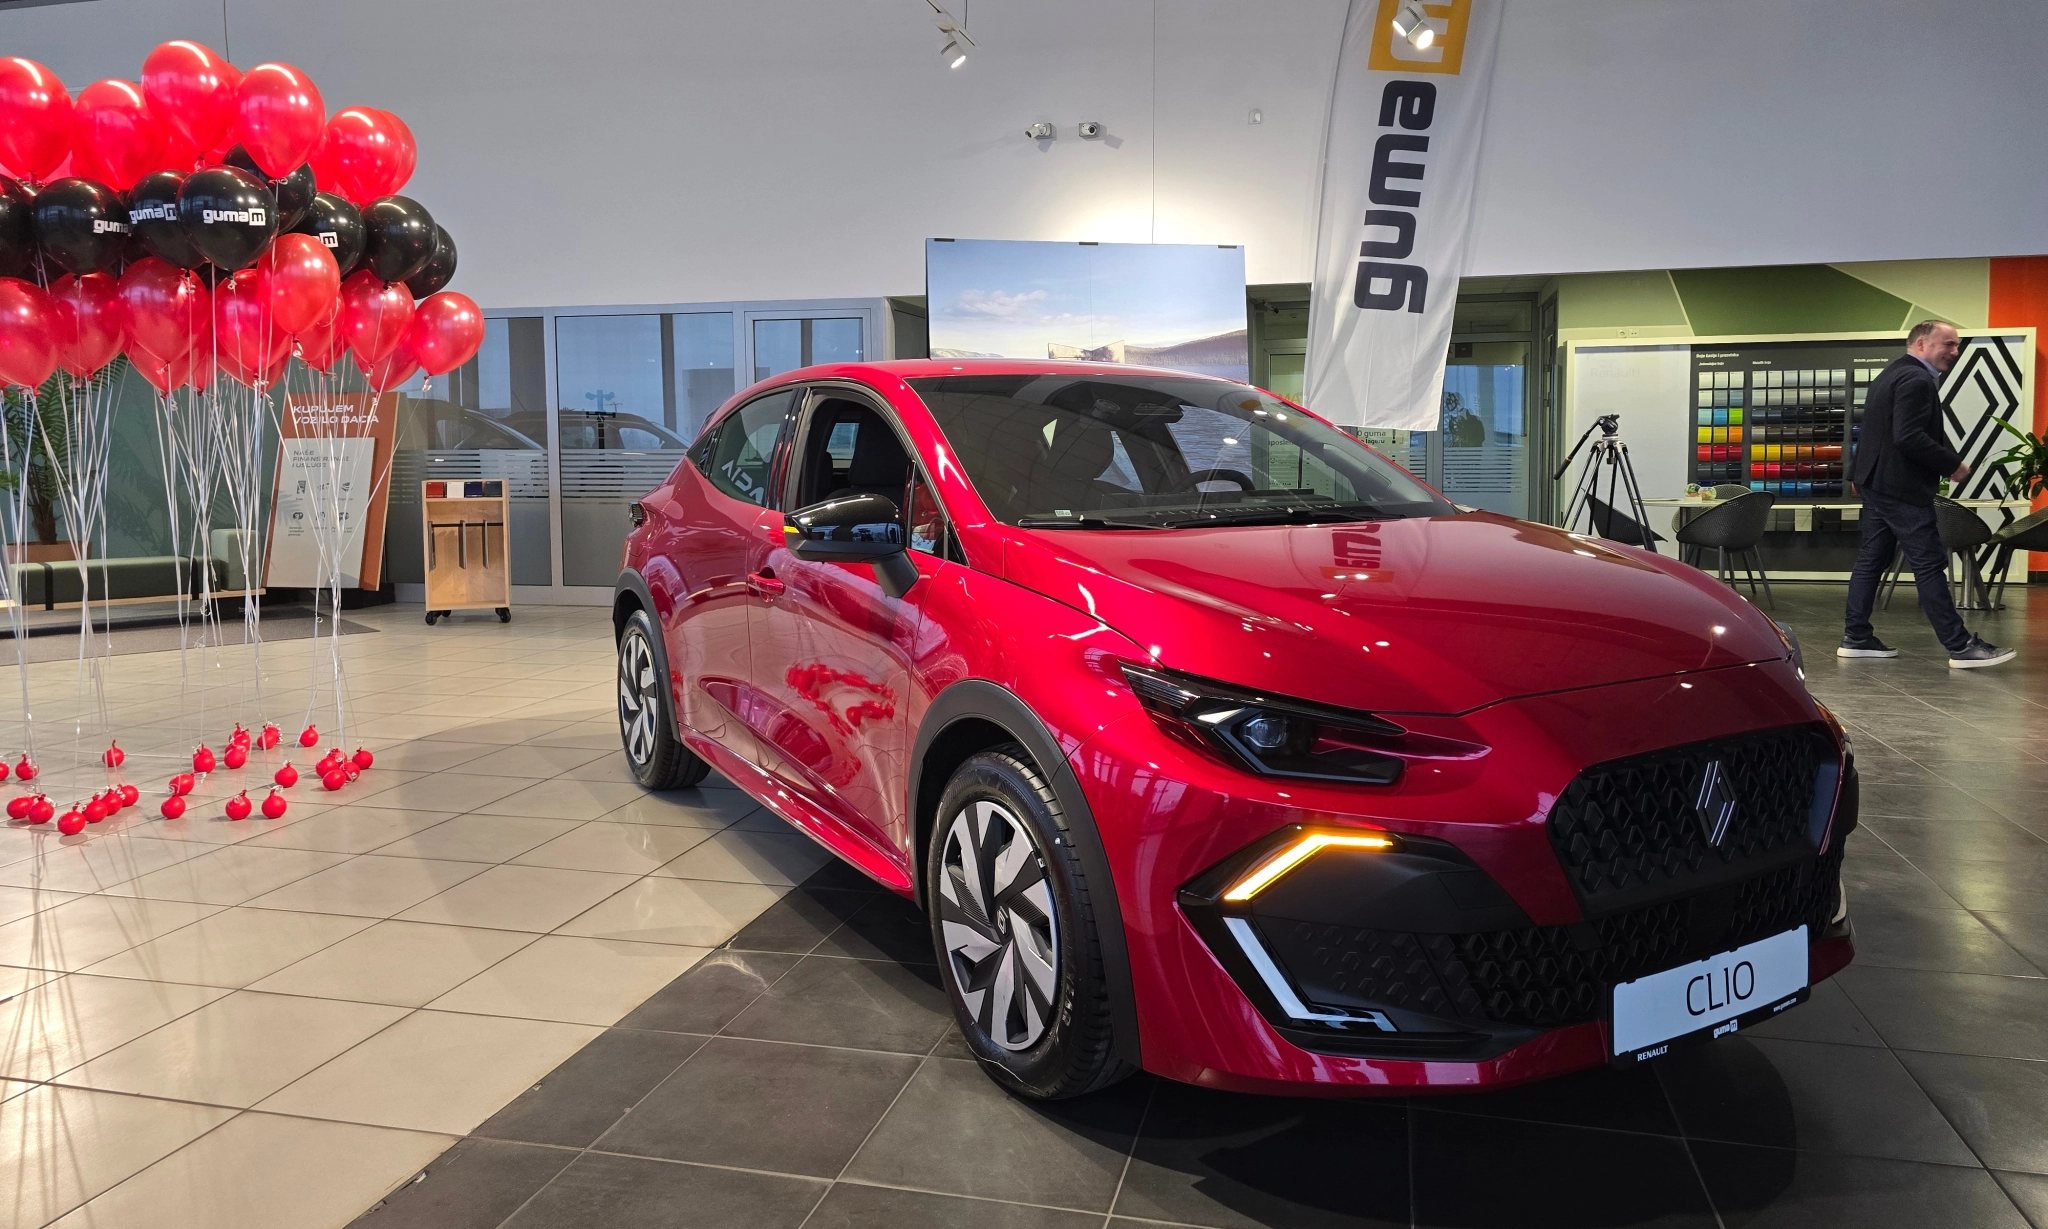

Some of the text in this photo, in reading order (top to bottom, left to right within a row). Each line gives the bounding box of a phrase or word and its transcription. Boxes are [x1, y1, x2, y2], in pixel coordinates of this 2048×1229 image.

[294, 405, 354, 413] KUPUJEM
[341, 415, 379, 424] DACIA
[1686, 961, 1755, 1016] CLIO
[1637, 1045, 1669, 1062] RENAULT
